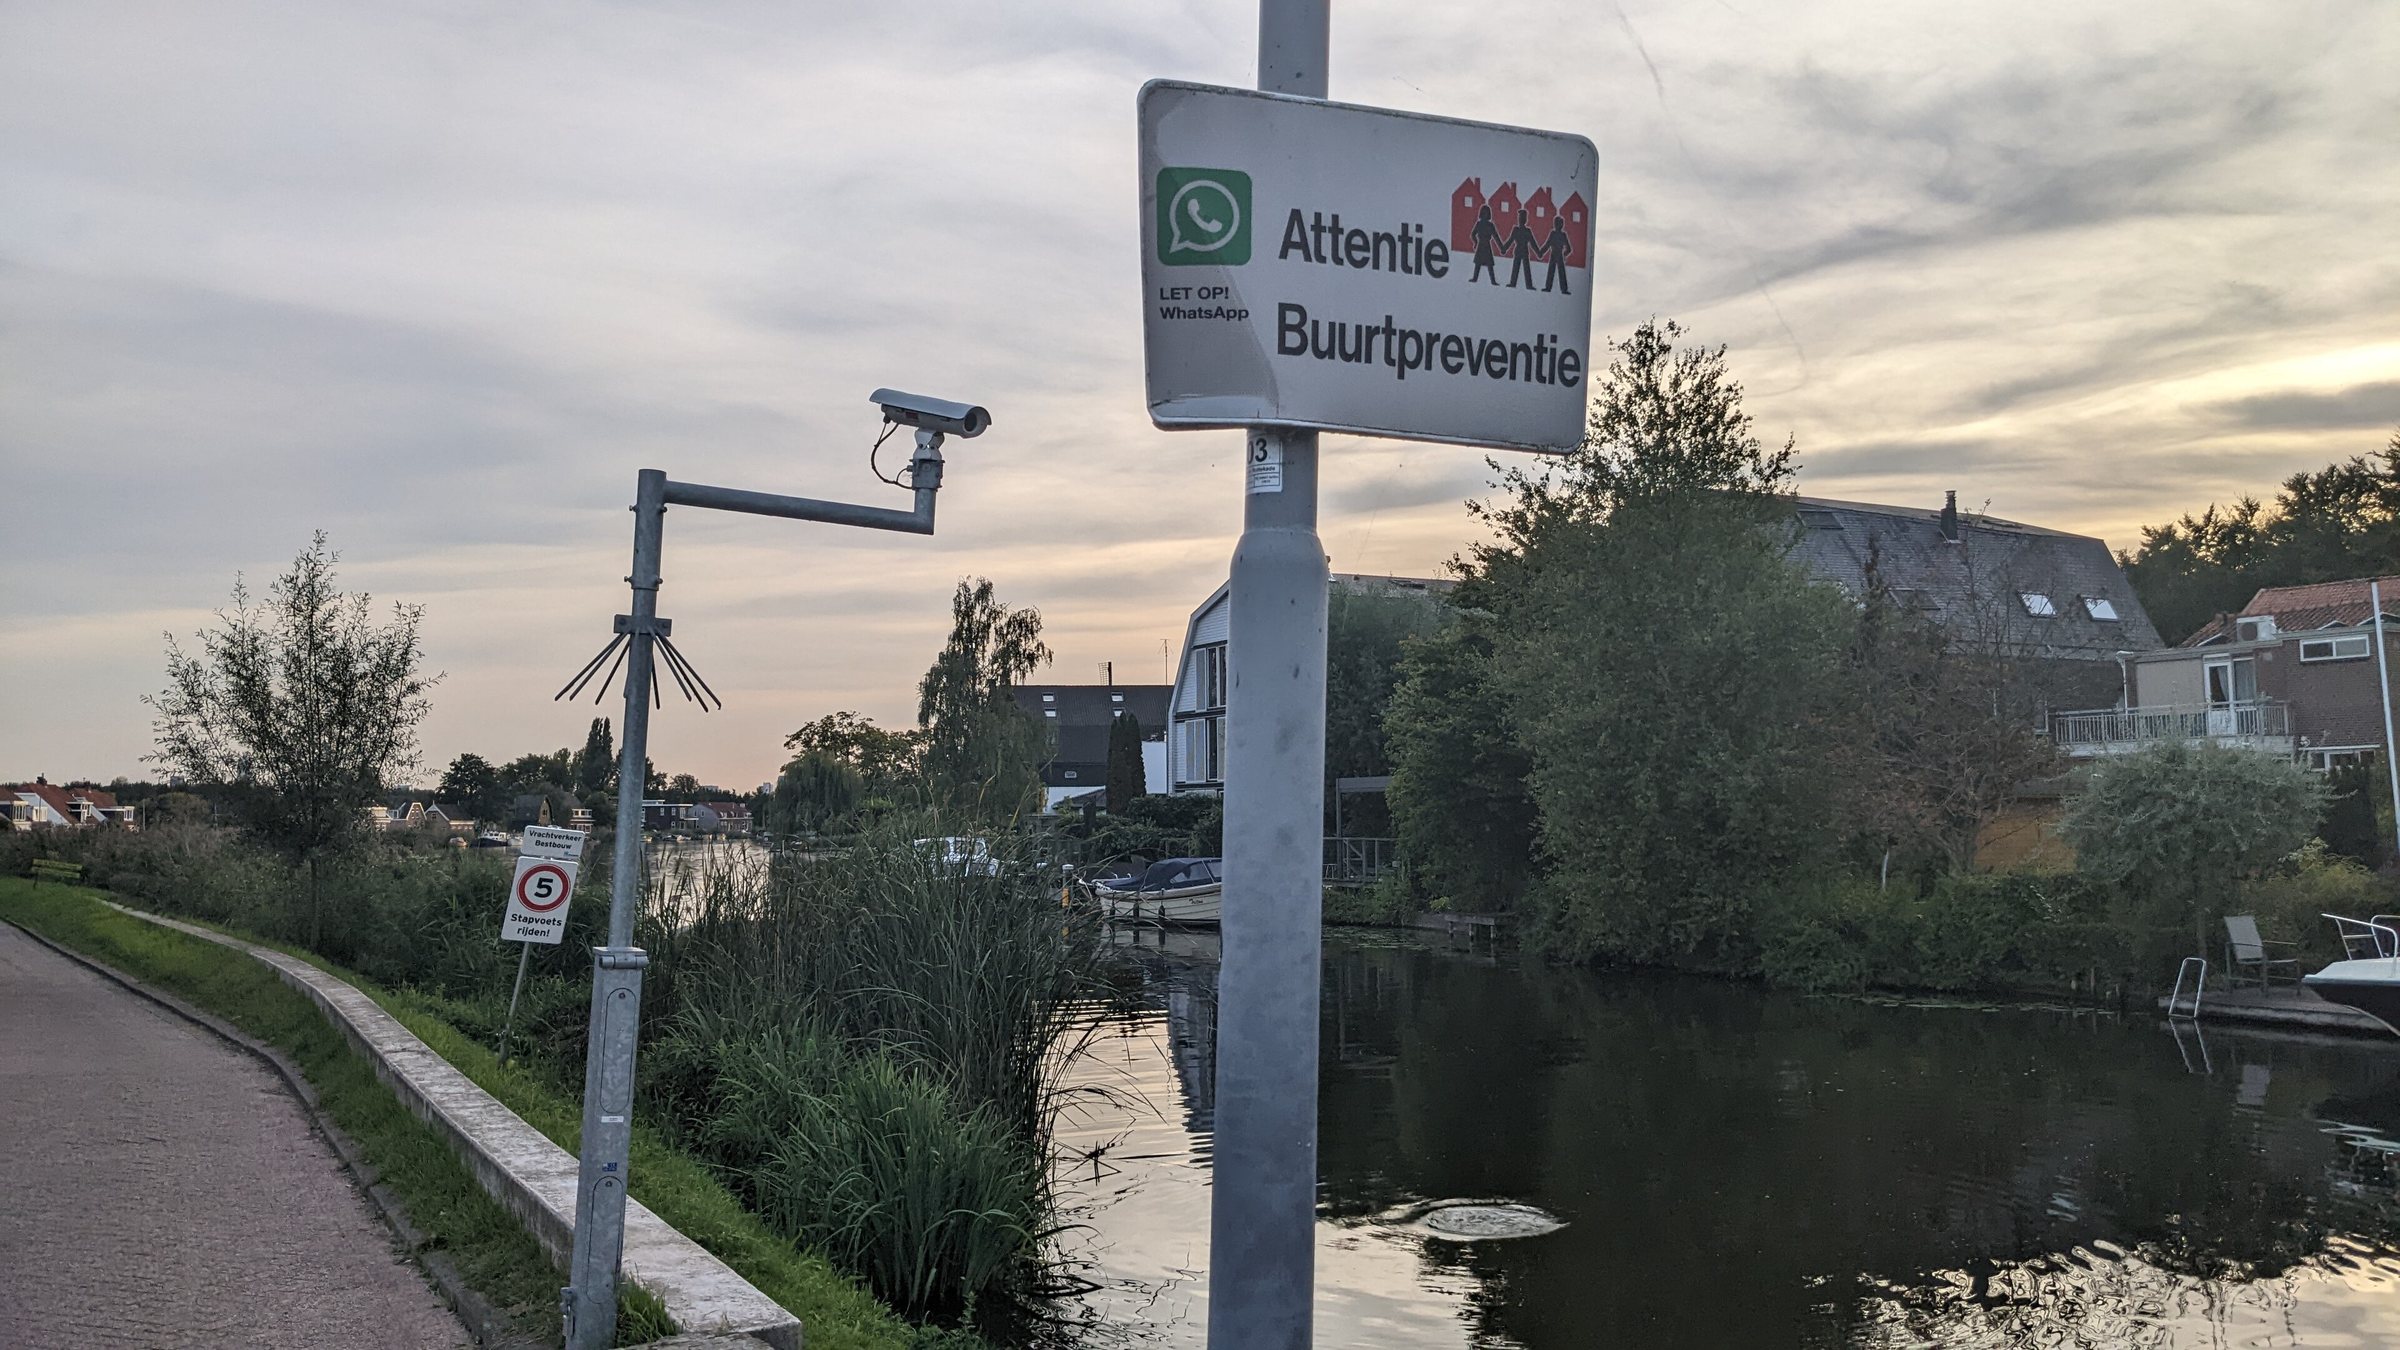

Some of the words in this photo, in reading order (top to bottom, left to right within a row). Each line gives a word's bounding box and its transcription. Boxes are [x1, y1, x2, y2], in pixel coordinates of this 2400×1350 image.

[1278, 208, 1450, 279] Attentie
[1160, 287, 1192, 300] LET
[1197, 286, 1229, 300] OP!
[1160, 306, 1250, 321] WhatsApp
[1277, 302, 1581, 388] Buurtpreventie
[529, 829, 582, 842] Vrachtverkeer
[534, 840, 572, 850] Bestbouw
[534, 877, 553, 898] 5
[511, 913, 562, 926] Stapvoets
[517, 926, 550, 937] rijden!
